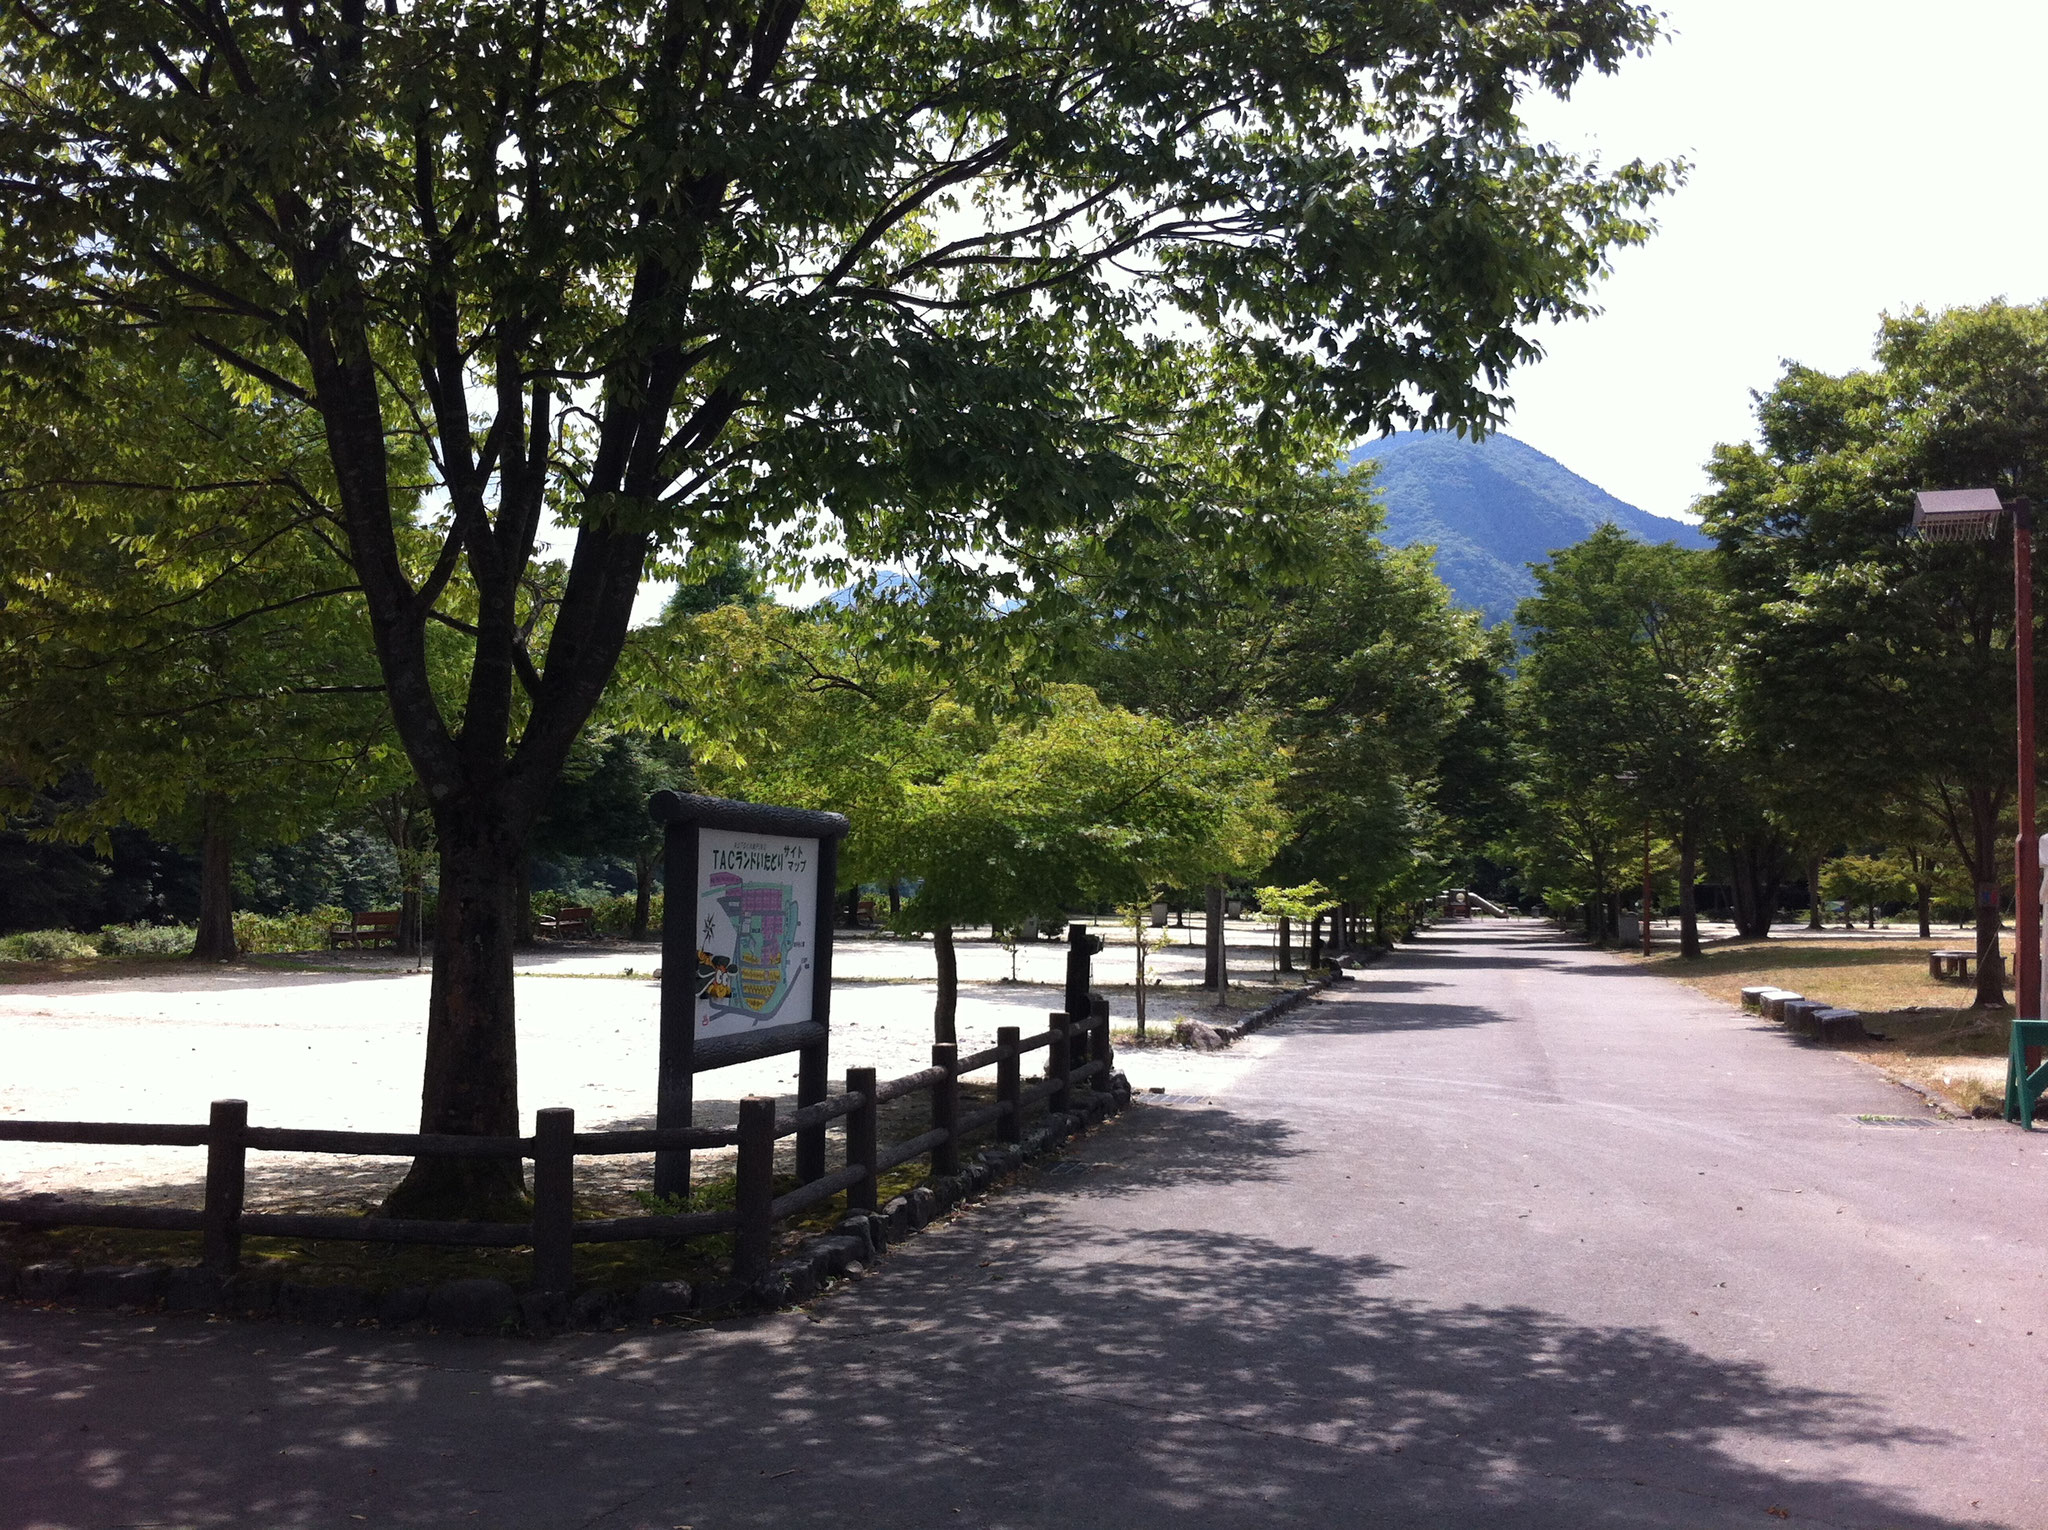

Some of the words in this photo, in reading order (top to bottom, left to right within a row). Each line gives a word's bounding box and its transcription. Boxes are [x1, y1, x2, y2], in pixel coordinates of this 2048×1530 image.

[783, 845, 803, 859] サイト
[787, 860, 807, 873] マップ
